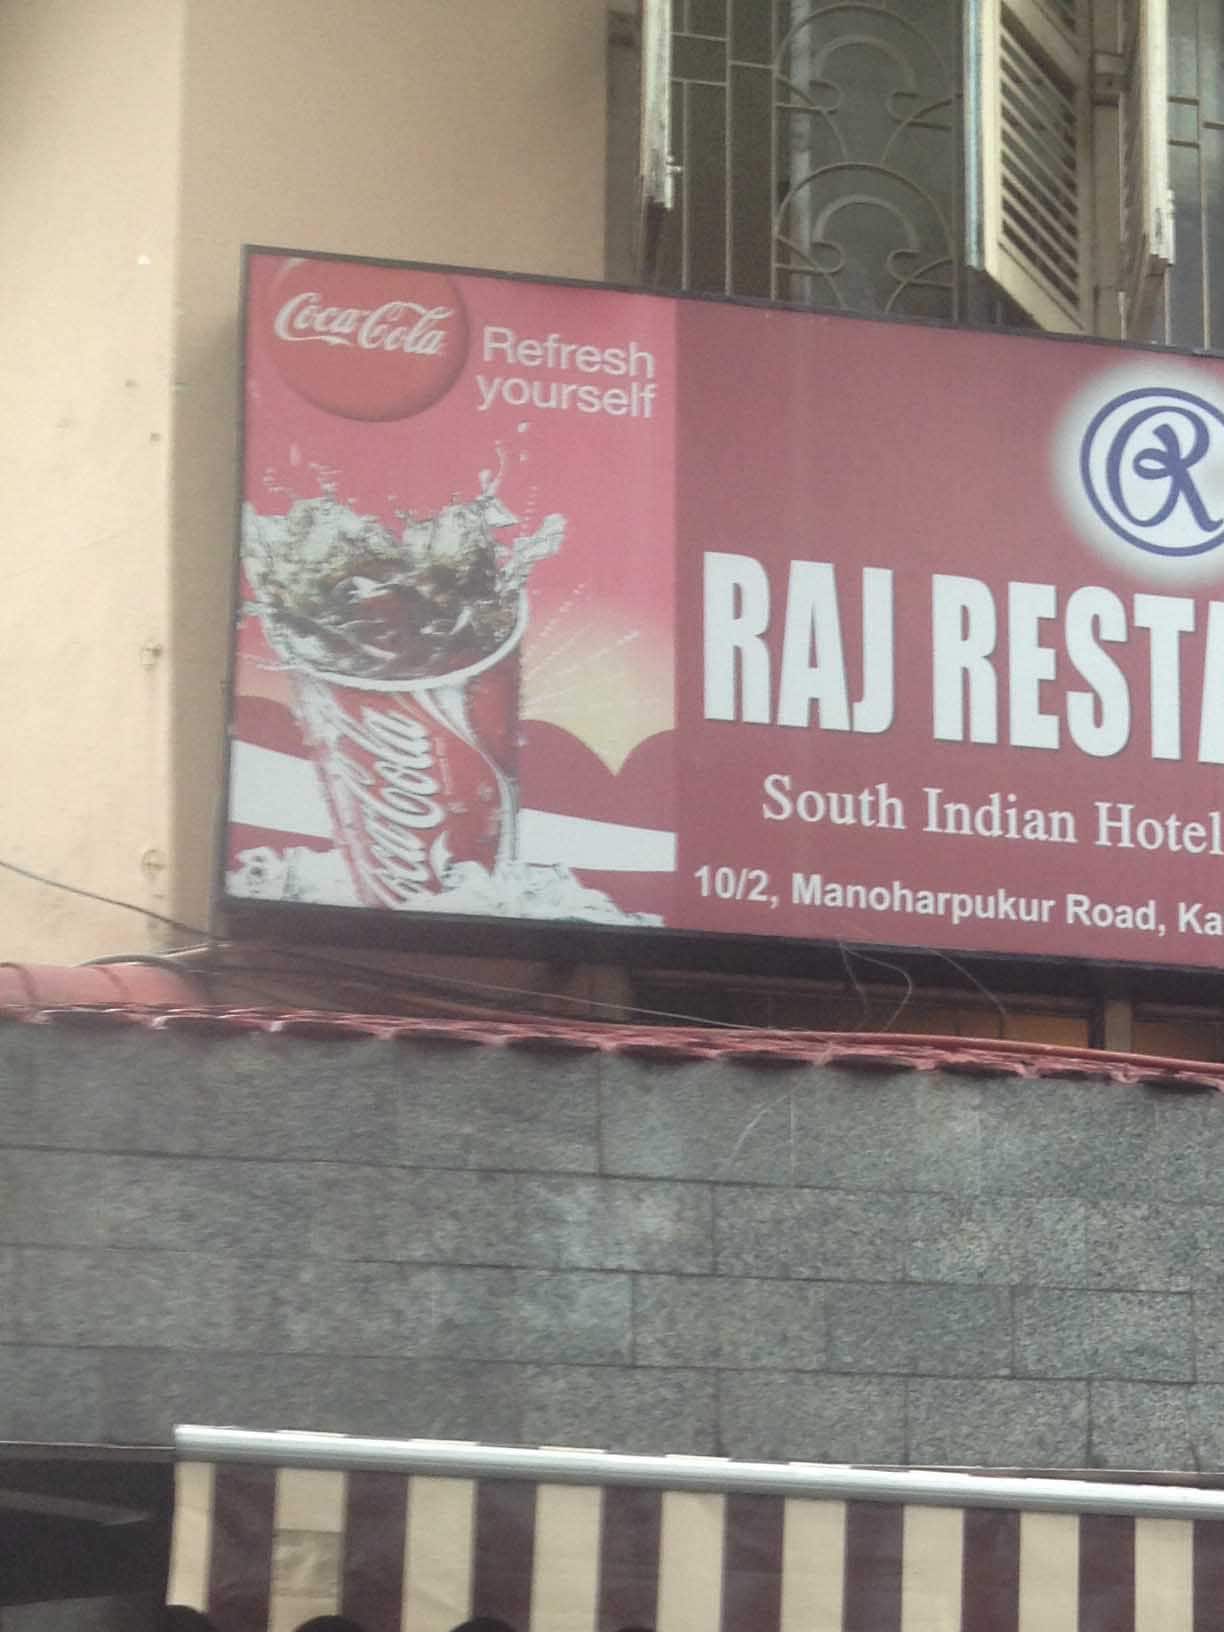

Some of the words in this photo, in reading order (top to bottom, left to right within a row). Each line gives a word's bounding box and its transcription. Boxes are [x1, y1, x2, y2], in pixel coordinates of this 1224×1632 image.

[274, 292, 455, 355] Coca-Cola
[482, 325, 656, 379] Refresh
[475, 374, 658, 418] yourself
[703, 551, 895, 734] RAJ
[762, 774, 906, 830] South
[922, 787, 1078, 844] Indian
[1094, 801, 1224, 856] Hotel
[694, 865, 779, 909] 10/2,
[792, 872, 1056, 924] Manoharpukur
[1066, 893, 1167, 936] Road,
